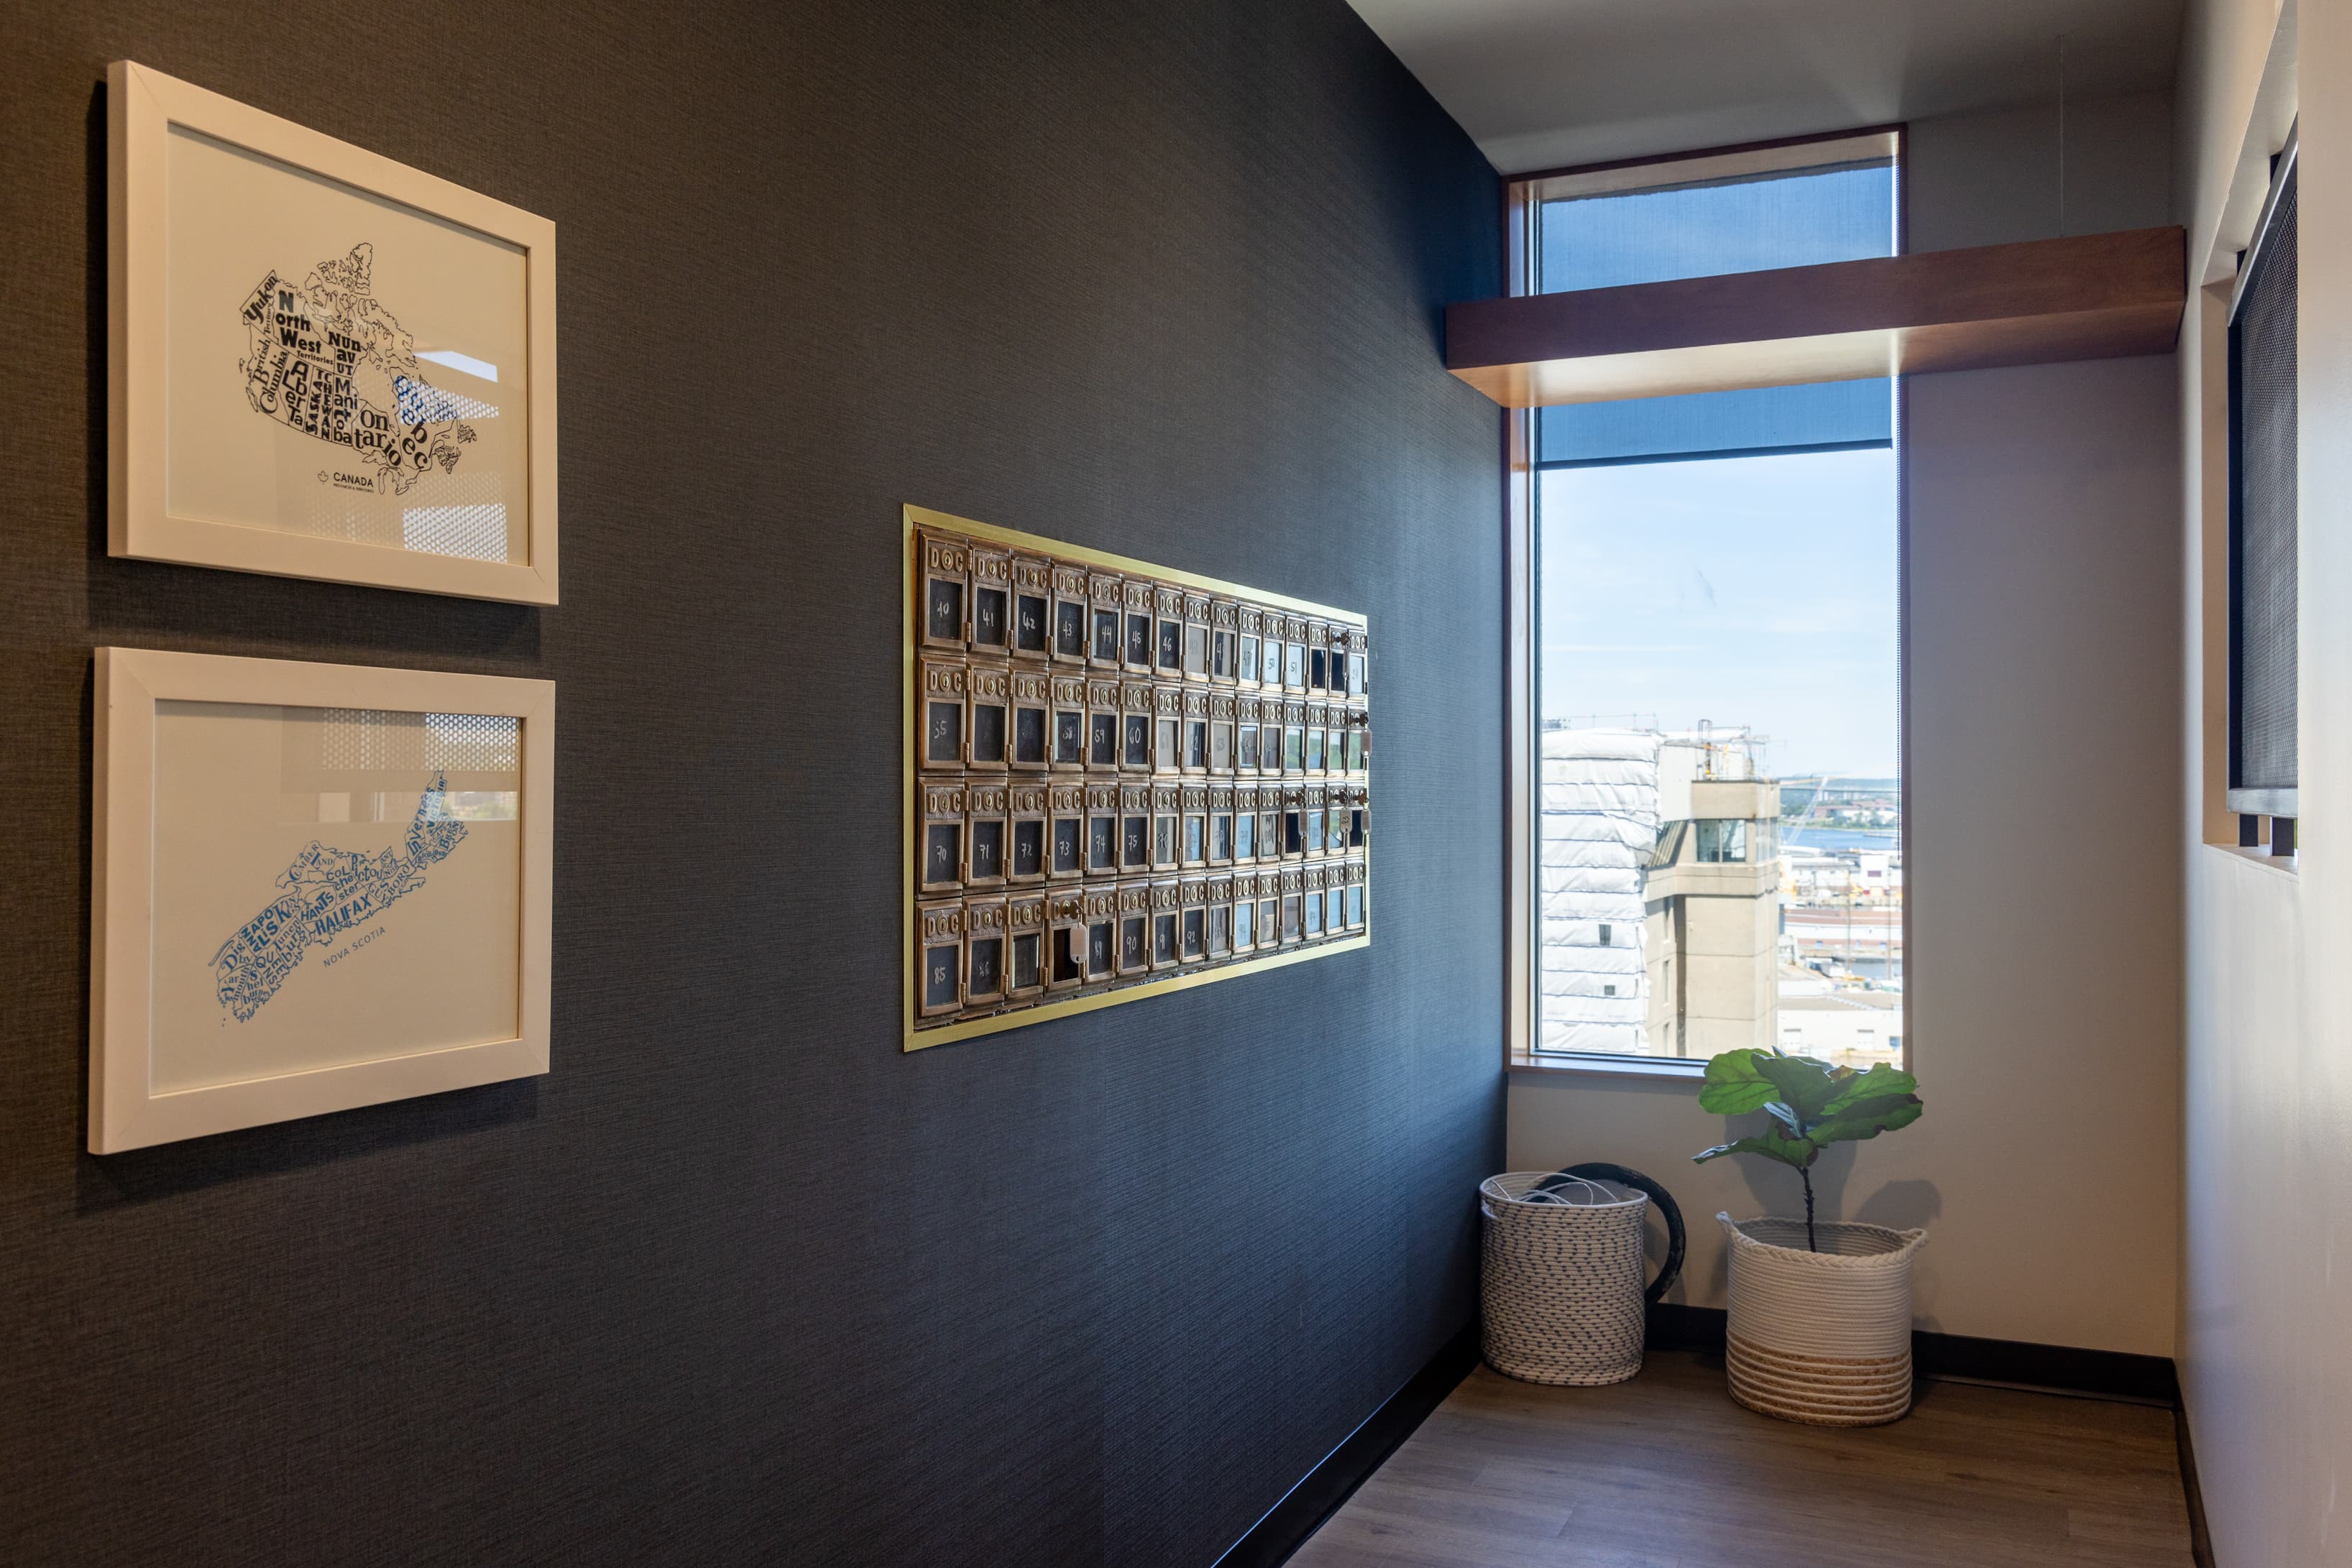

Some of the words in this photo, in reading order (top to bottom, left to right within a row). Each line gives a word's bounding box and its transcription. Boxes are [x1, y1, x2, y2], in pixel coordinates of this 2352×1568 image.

[244, 275, 278, 324] Yukon
[280, 327, 322, 354] West
[253, 338, 271, 385] British
[297, 351, 334, 365] Territories
[259, 351, 289, 414] Columbia
[334, 472, 374, 487] CANADA
[931, 547, 963, 572] DOC
[978, 557, 1006, 580] DOC
[1019, 566, 1047, 589] DOC
[1060, 574, 1084, 595] DOC
[1095, 583, 1118, 601] DOC
[1128, 589, 1150, 608] DOC
[1160, 597, 1180, 614] DOC
[1189, 603, 1208, 617] DOC
[983, 609, 994, 627] 41
[1022, 611, 1036, 631] 42
[1216, 608, 1235, 623] DOC
[1243, 614, 1259, 630] DOC
[1062, 620, 1072, 639] 43
[1101, 624, 1112, 644] 44
[1267, 620, 1283, 635] DOC
[1290, 624, 1305, 639] DOC
[1311, 628, 1326, 642] DOC
[1131, 630, 1141, 650] 45
[1162, 636, 1172, 652] 46
[1351, 635, 1365, 650] DOC
[929, 670, 962, 692] DOC
[975, 674, 1006, 696] DOC
[1016, 678, 1046, 698] DOC
[1057, 683, 1082, 702] DOC
[1093, 688, 1116, 705] DOC
[1127, 689, 1149, 708] DOC
[1159, 694, 1178, 711] DOC
[1188, 696, 1206, 714] DOC
[1213, 701, 1233, 716] DOC
[1241, 703, 1258, 718] DOC
[1264, 705, 1281, 719] DOC
[1287, 706, 1303, 721] DOC
[1310, 709, 1326, 723] DOC
[1331, 711, 1345, 724] DOC
[1094, 729, 1105, 744] 59
[1129, 727, 1141, 744] 60
[929, 792, 960, 813] DOC
[974, 792, 1003, 811] DOC
[1015, 792, 1043, 812] DOC
[1054, 791, 1080, 810] DOC
[1092, 790, 1114, 808] DOC
[1125, 790, 1147, 809] DOC
[1157, 792, 1176, 808] DOC
[1187, 791, 1205, 808] DOC
[1213, 792, 1231, 808] DOC
[1239, 793, 1255, 807] DOC
[1262, 792, 1279, 807] DOC
[1309, 791, 1323, 806] DOC
[979, 844, 989, 860] 71
[1021, 842, 1032, 858] 72
[1059, 840, 1070, 856] 73
[1095, 834, 1106, 853] 74
[1128, 834, 1138, 852] 75
[936, 844, 947, 864] 70
[1285, 874, 1300, 890] DOC
[1308, 872, 1323, 887] DOC
[1329, 869, 1343, 884] DOC
[1349, 867, 1363, 880] DOC
[1185, 885, 1203, 903] DOC
[1212, 884, 1230, 900] DOC
[1238, 879, 1254, 895] DOC
[1262, 877, 1277, 893] DOC
[300, 891, 334, 921] HANTS
[1090, 896, 1113, 916] DOC
[1123, 892, 1145, 911] DOC
[1156, 889, 1176, 908] DOC
[315, 893, 372, 936] HALIFAX
[973, 909, 1002, 929] DOC
[1014, 904, 1041, 926] DOC
[927, 914, 958, 937] DOC
[323, 948, 349, 967] NOVA
[353, 926, 387, 955] SCOTIA
[1126, 936, 1137, 955] 90
[1159, 933, 1165, 951] 91
[1187, 931, 1196, 946] 92
[934, 967, 946, 984] 85
